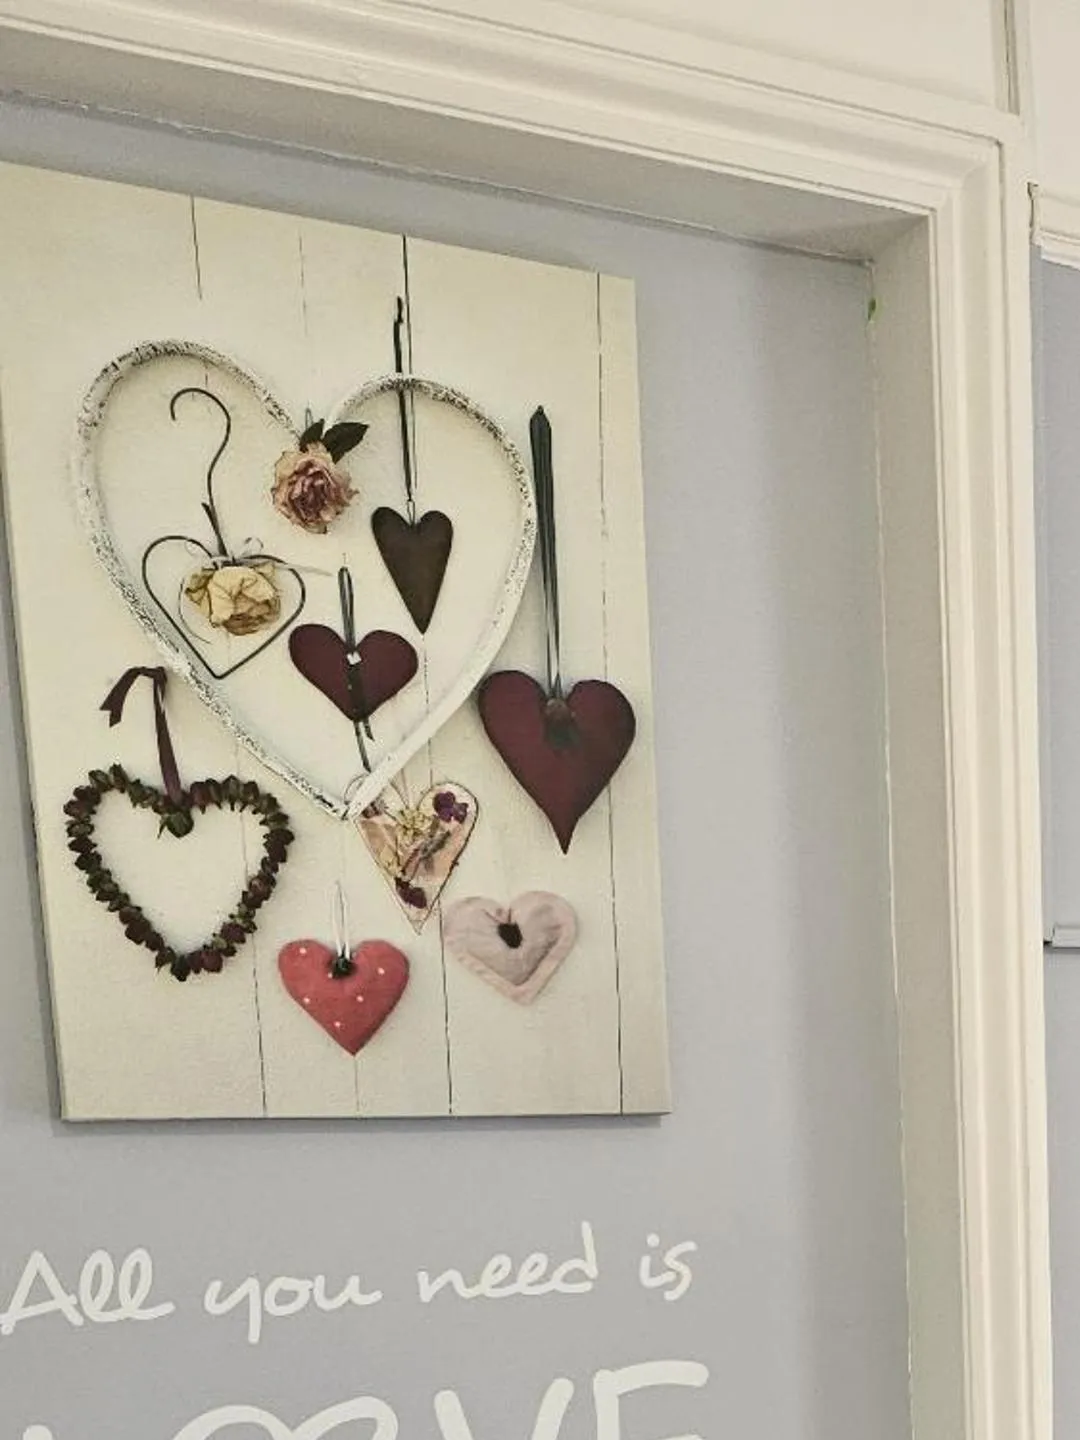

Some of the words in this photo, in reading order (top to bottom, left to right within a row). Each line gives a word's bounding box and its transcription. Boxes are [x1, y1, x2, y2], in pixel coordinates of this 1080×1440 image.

[0, 1249, 175, 1335] All
[204, 1274, 382, 1343] you
[417, 1221, 598, 1302] need
[640, 1234, 697, 1301] is
